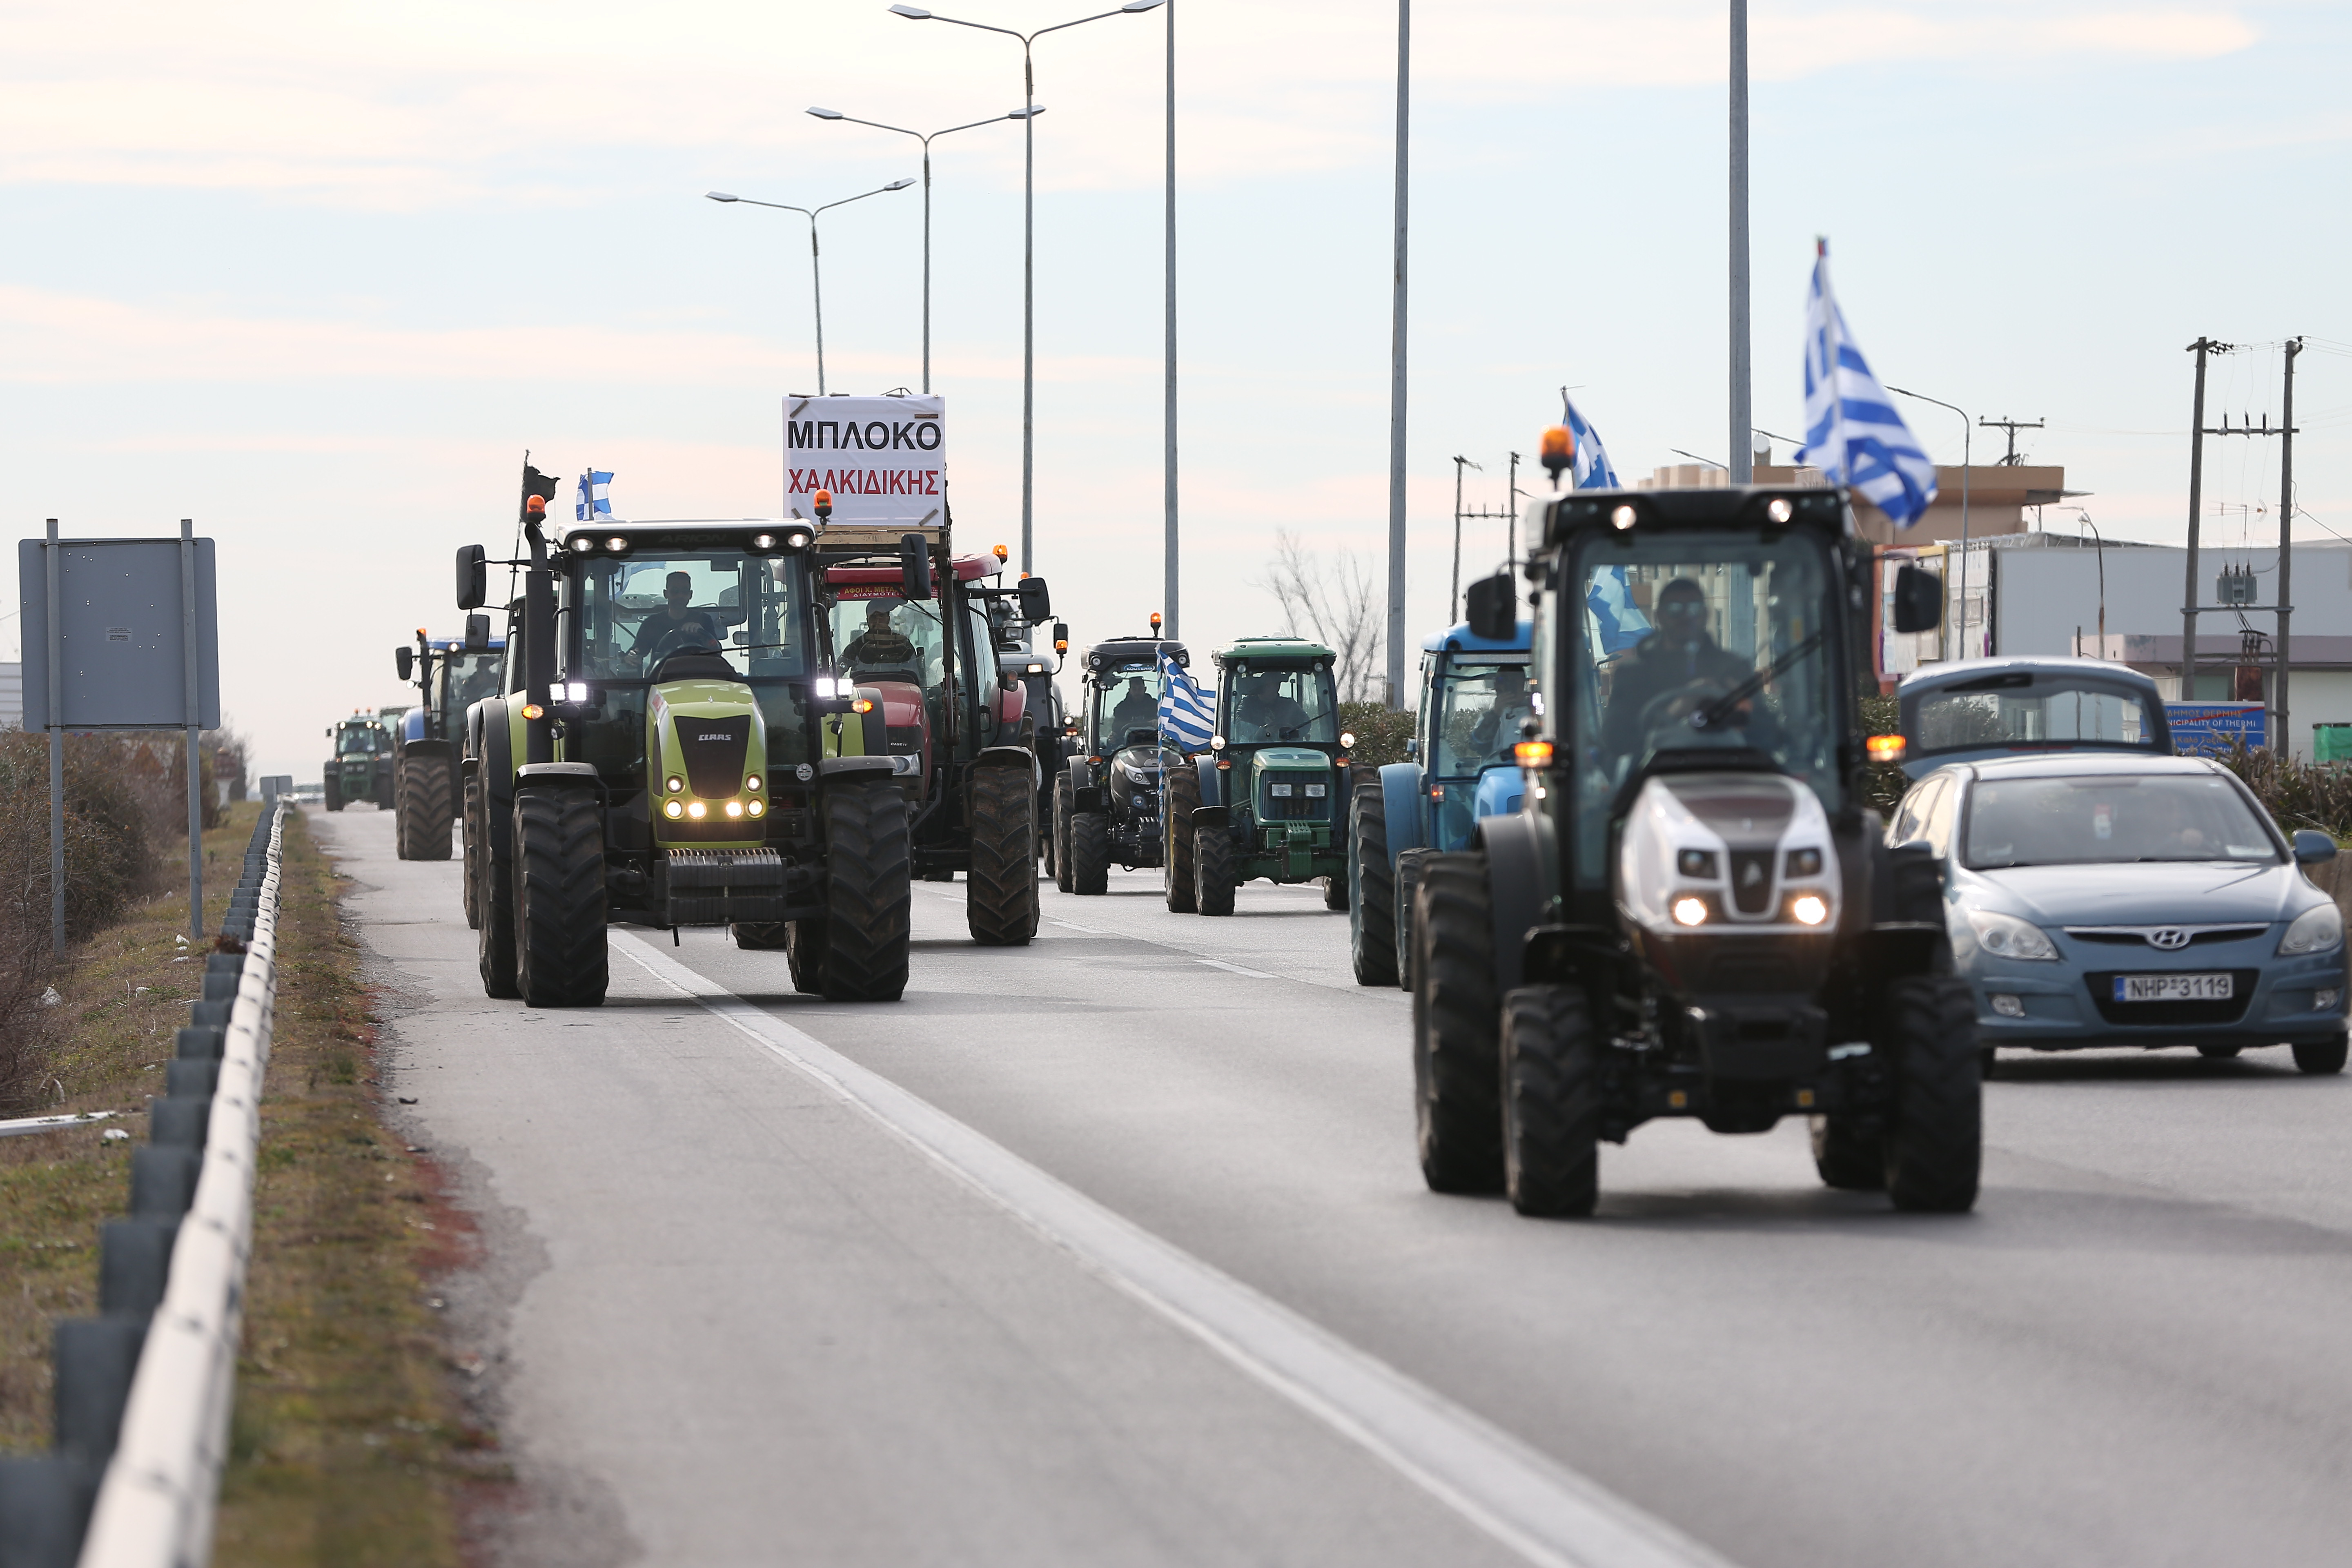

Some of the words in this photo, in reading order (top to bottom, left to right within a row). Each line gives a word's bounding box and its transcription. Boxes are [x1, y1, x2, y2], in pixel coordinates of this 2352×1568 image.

[788, 421, 941, 450] ΜΠΛΟΚΟ
[788, 469, 939, 495] ΧΑΛΚΙΔΙΚΗΣ
[2167, 709, 2201, 717] ΔΗΜΟΣ
[2203, 709, 2243, 718] ΘΕΡΜΗΣ
